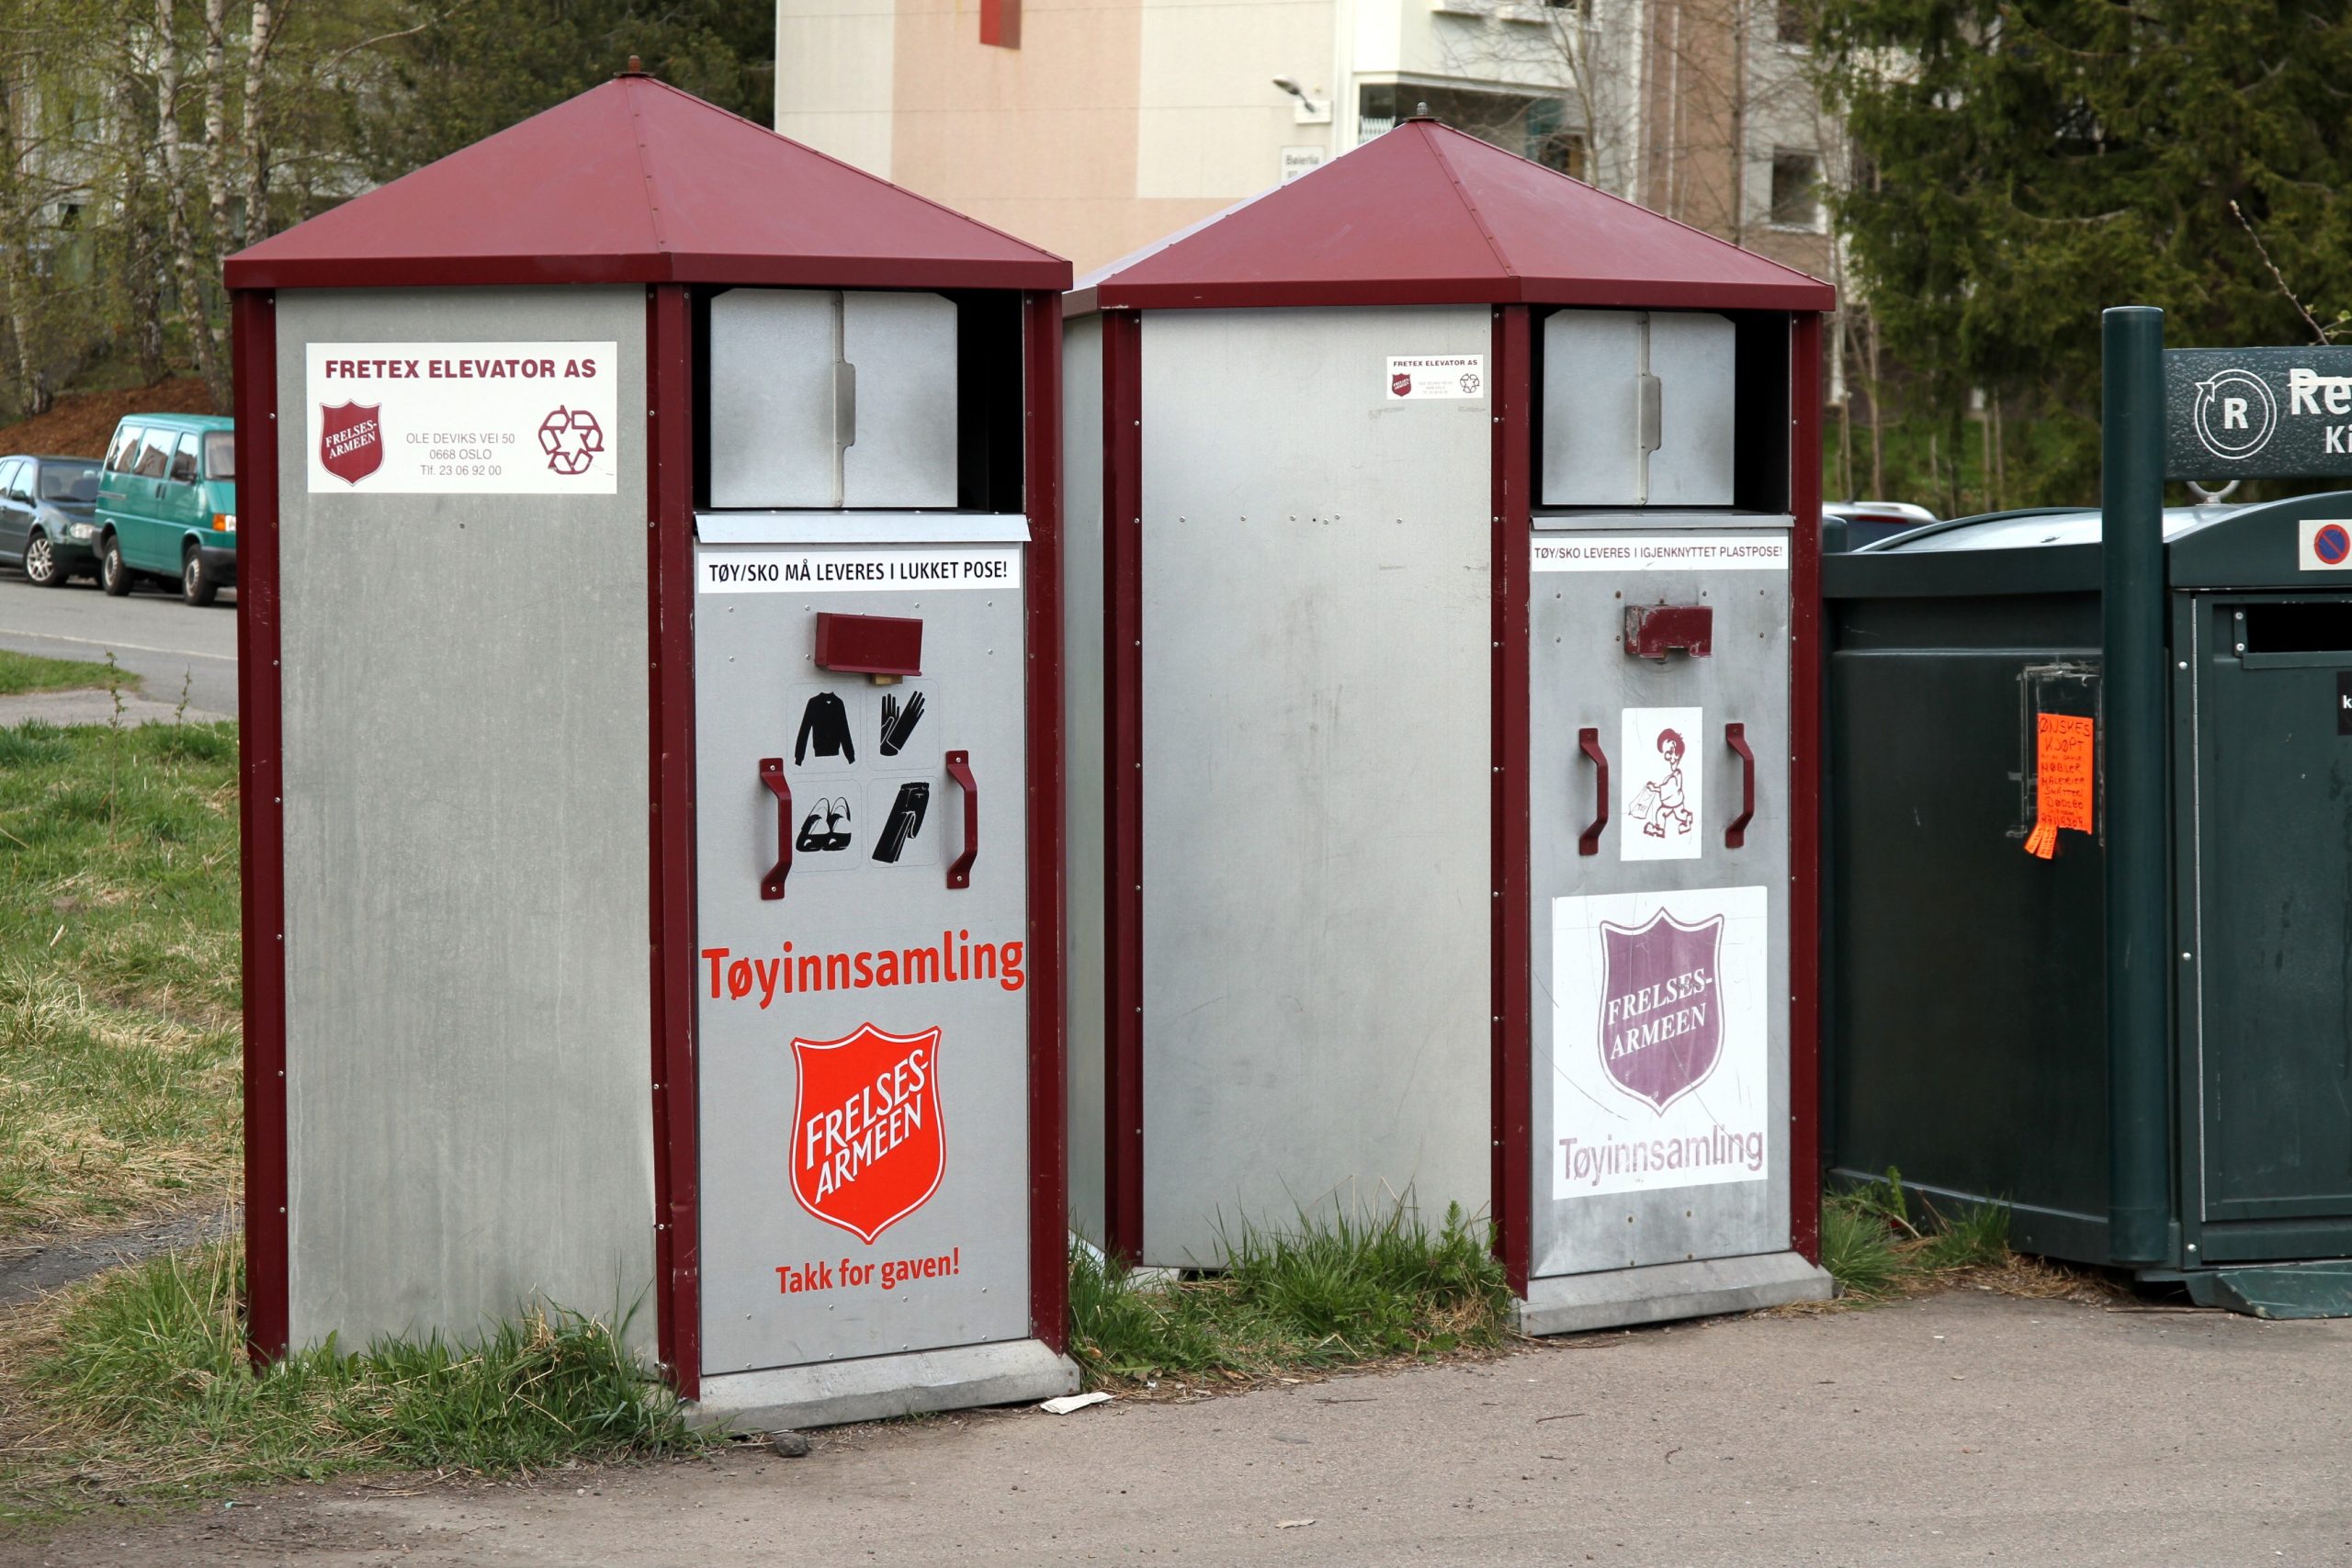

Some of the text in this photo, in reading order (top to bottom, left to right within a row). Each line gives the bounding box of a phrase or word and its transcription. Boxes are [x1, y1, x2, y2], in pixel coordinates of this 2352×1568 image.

[325, 358, 597, 378] FRETEX ELEVATOR AS
[2223, 398, 2249, 430] R
[325, 419, 378, 448] FRELSES-
[329, 431, 376, 459] ARMEEN
[405, 433, 515, 445] OLE DEVIKS VEI 50
[429, 448, 492, 460] 0668 OSLO
[420, 464, 502, 476] Tlf. 23 06 92 00
[1534, 546, 1782, 558] TØY/SKO LEVERES I IGJENKNYTTET PLASTPOSE!
[709, 558, 1007, 582] TØY/SKO MÅ LEVERES I LUKKET POSE!
[2039, 717, 2091, 737] ØNSKES
[702, 930, 1025, 1010] Tøyinnsamling
[1608, 968, 1713, 1025] FRELSES-
[1610, 1003, 1708, 1060] ARMEEN
[806, 1048, 929, 1170] FRELSES-
[814, 1094, 922, 1205] ARMEEN
[1558, 1124, 1764, 1187] Tøyinnsamling
[775, 1247, 960, 1294] Takk for gaven!
